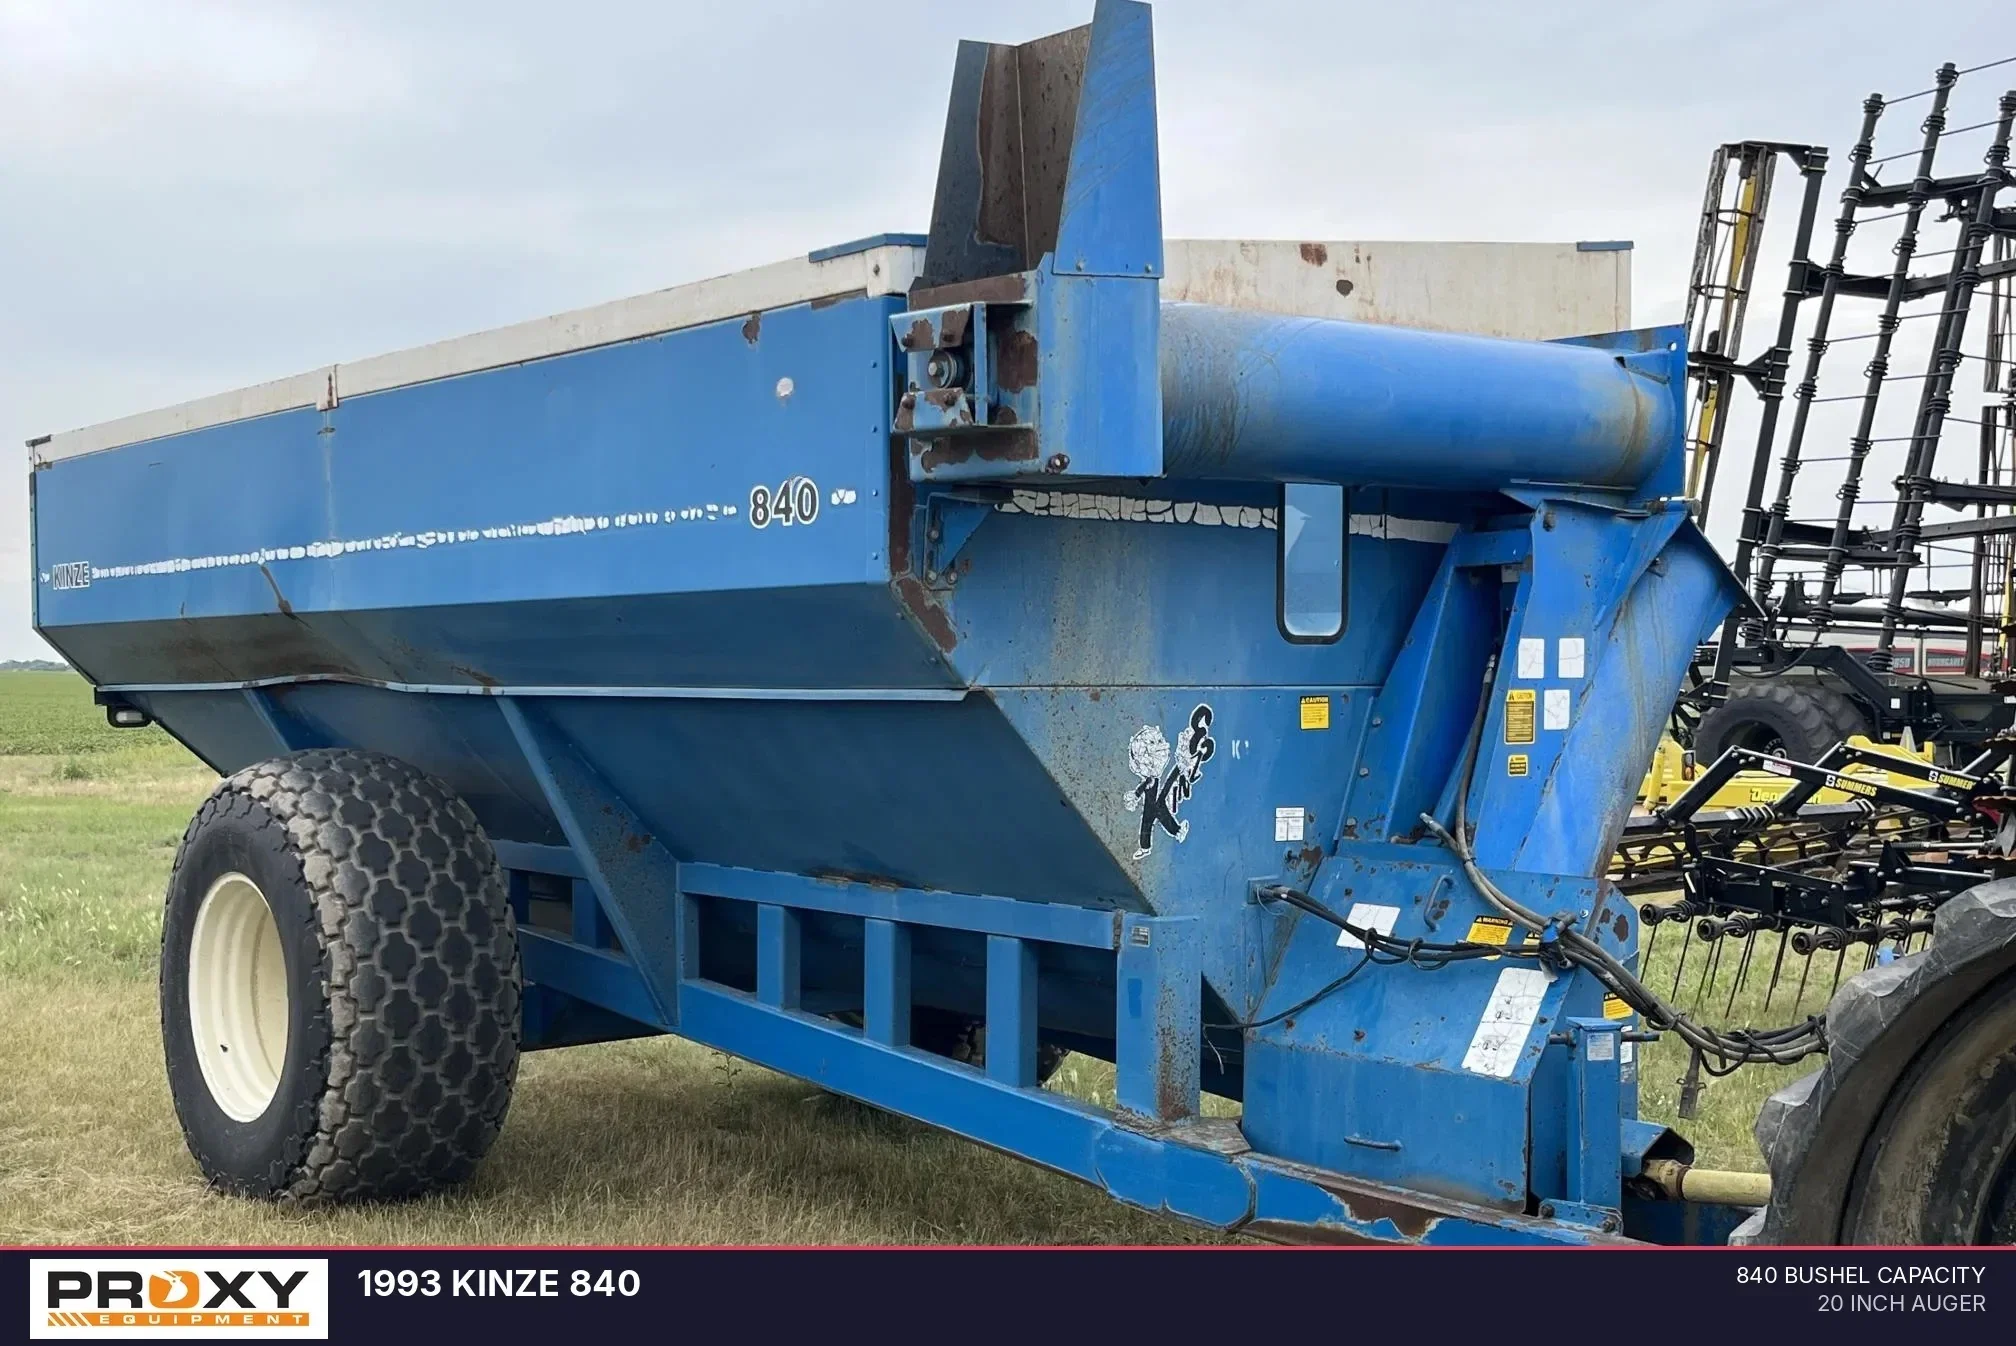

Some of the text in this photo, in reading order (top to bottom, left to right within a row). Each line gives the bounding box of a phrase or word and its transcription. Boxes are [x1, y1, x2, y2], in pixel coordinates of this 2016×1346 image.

[750, 477, 819, 529] 840
[53, 561, 90, 590] KINZE
[1835, 778, 1878, 797] SUMMERS
